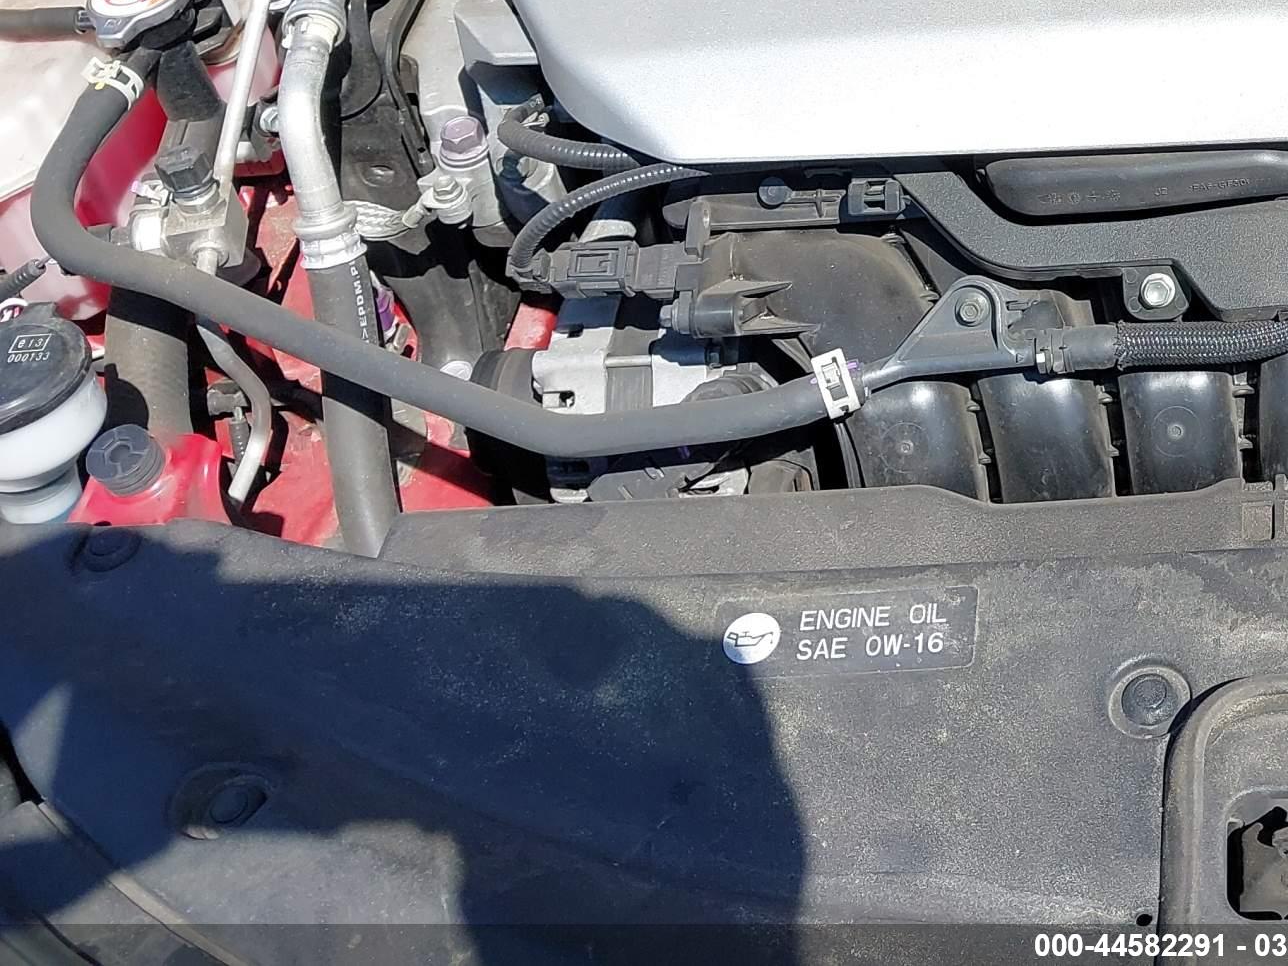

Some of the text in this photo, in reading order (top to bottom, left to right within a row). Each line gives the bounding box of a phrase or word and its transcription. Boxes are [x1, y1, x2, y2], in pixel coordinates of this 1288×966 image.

[7, 351, 51, 363] 000133
[799, 602, 948, 632] ENGINE OIL
[796, 633, 945, 661] SAE 0W-16
